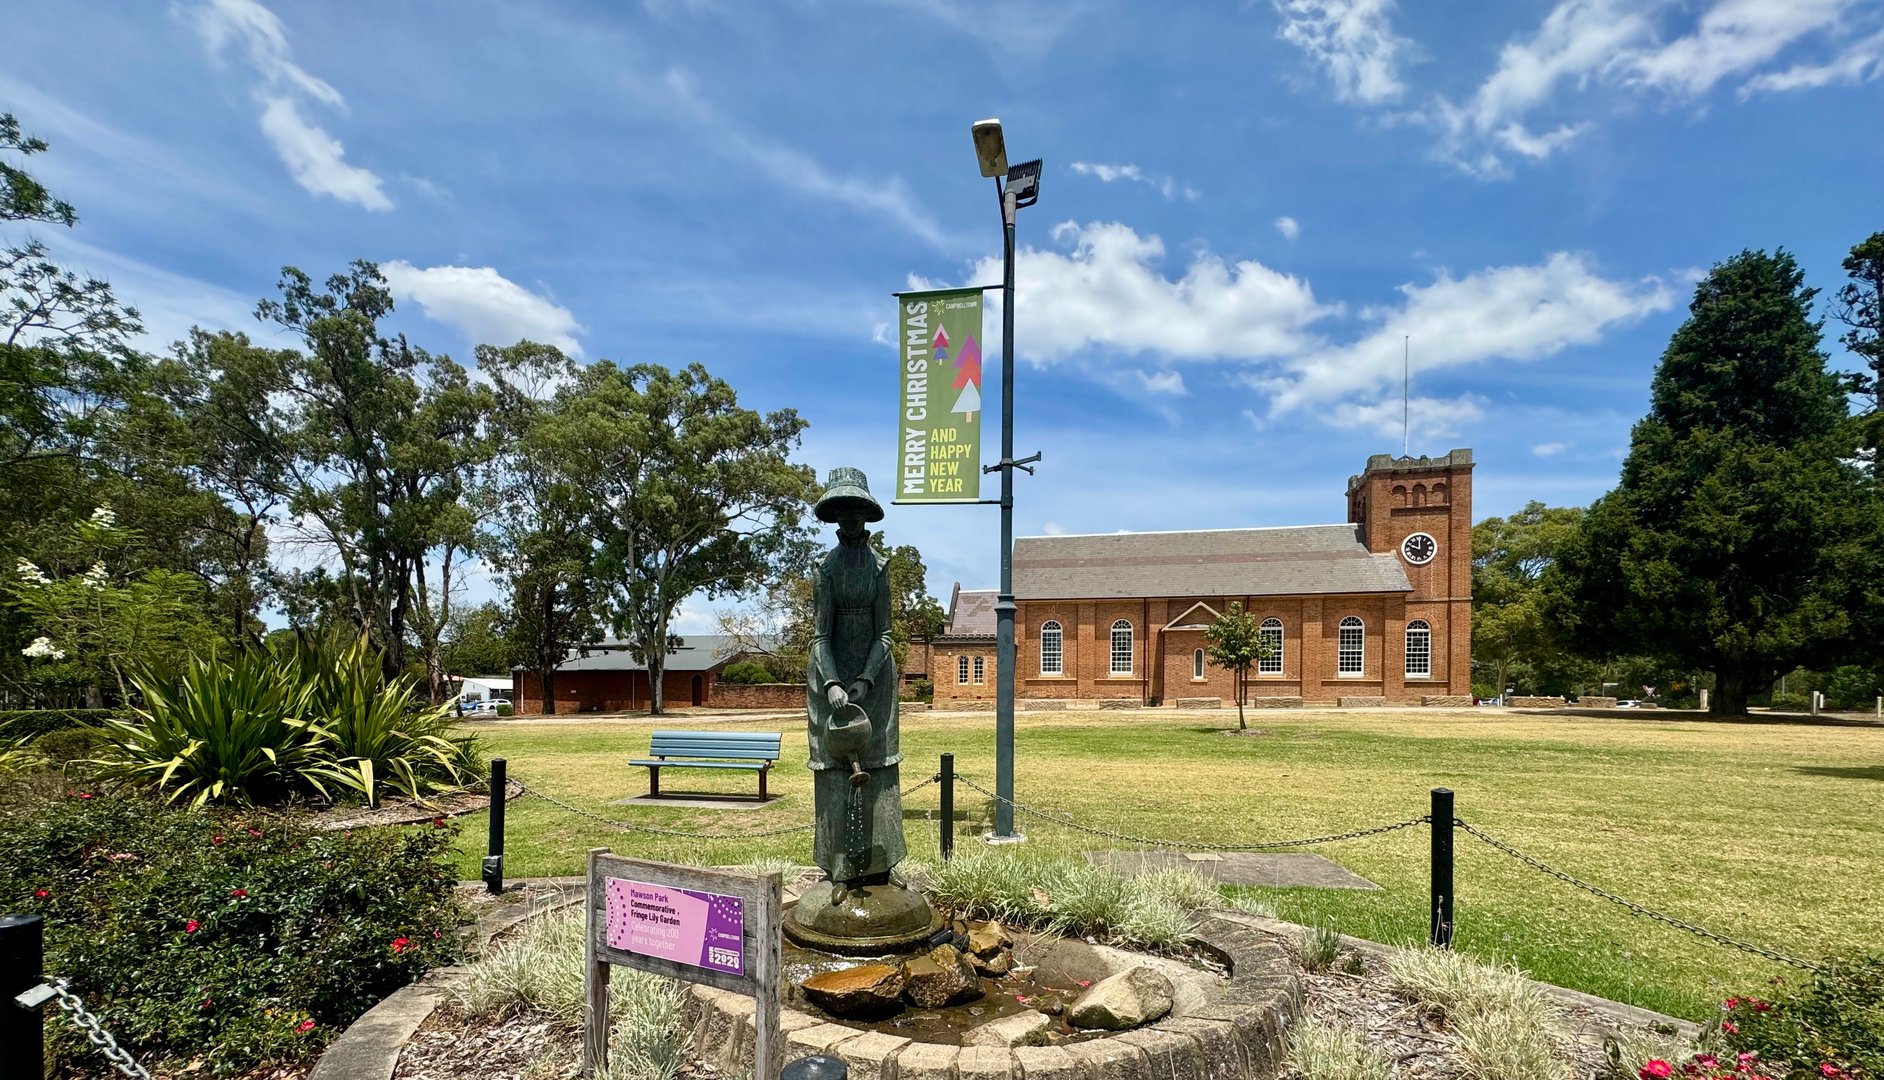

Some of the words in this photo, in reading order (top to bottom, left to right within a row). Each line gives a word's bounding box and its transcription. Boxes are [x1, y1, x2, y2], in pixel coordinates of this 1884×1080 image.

[906, 301, 928, 421] CHRISTMAS
[931, 428, 957, 443] AND
[931, 444, 972, 459] HAPPY
[904, 428, 927, 494] MERRY
[930, 462, 959, 476] NEW
[929, 478, 963, 493] YEAR
[631, 889, 653, 900] Mawson
[654, 893, 668, 903] Park
[631, 899, 676, 915] Commemorative
[631, 909, 648, 921] Fringe
[649, 913, 659, 924] Lily
[660, 914, 680, 926] Garden
[631, 921, 666, 938] Celebrating
[667, 927, 679, 939] 200
[631, 935, 648, 945] years
[648, 938, 675, 950] together
[714, 953, 740, 969] 2020
